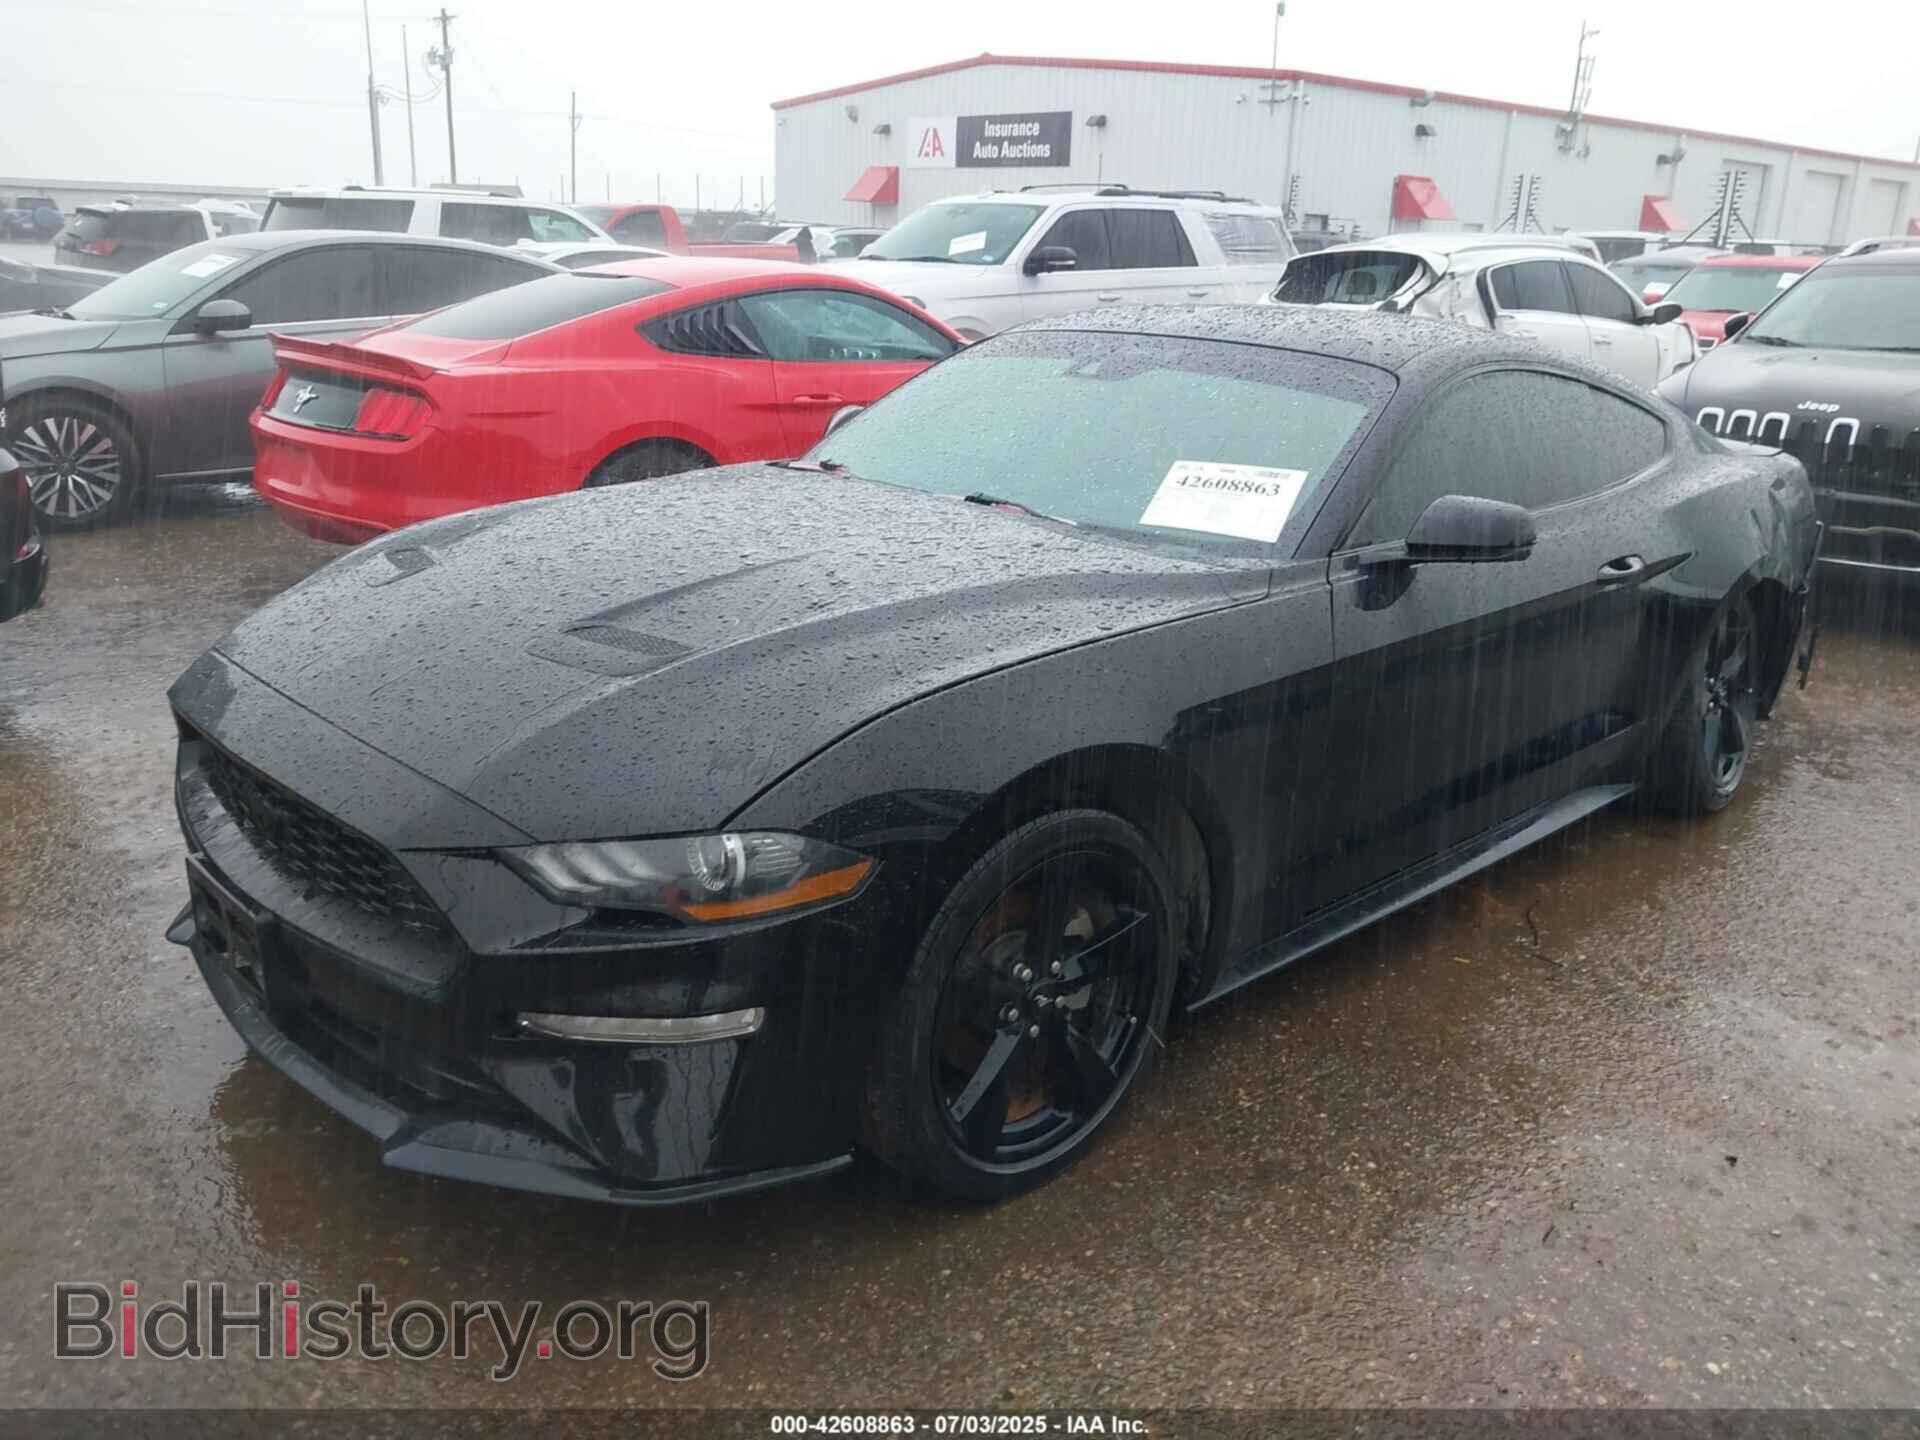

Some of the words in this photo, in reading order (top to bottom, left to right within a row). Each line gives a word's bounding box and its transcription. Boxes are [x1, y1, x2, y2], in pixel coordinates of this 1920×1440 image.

[984, 120, 1041, 137] Insurance
[972, 142, 999, 159] Auto
[1000, 140, 1051, 158] Auctions
[1797, 400, 1840, 413] Jeep
[1175, 474, 1281, 497] 42608863
